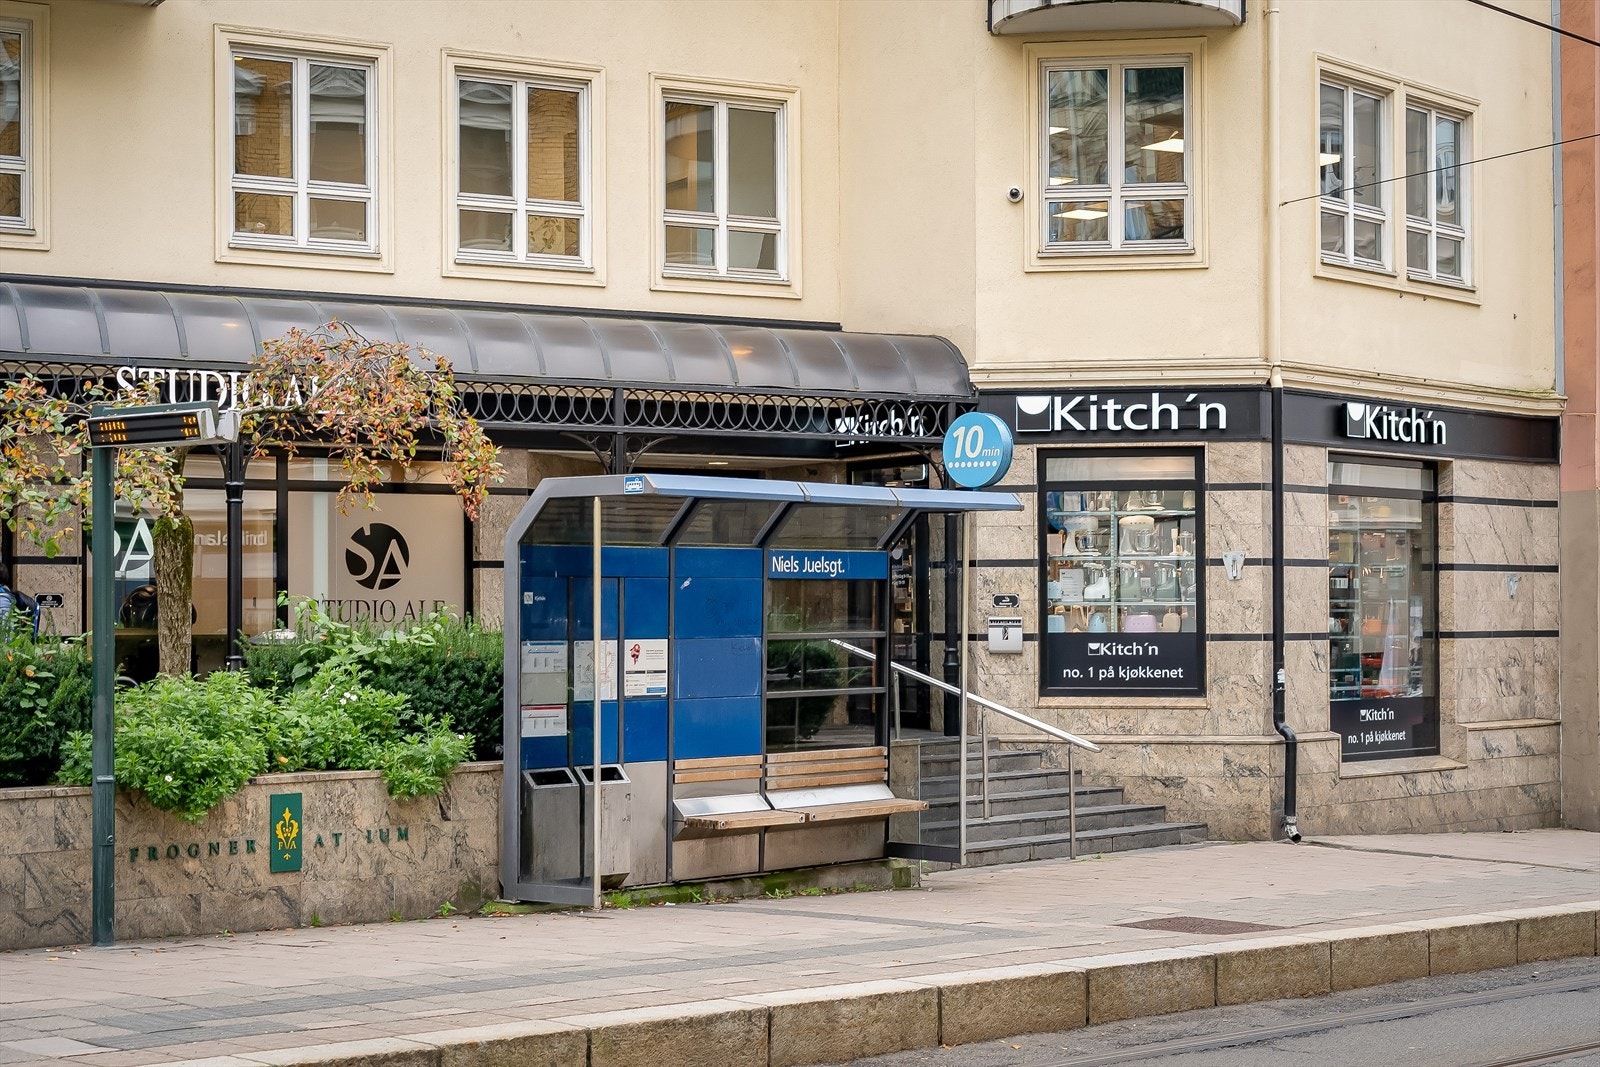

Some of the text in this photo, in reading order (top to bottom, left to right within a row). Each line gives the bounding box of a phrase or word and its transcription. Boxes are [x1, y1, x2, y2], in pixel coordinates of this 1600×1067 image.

[953, 425, 1000, 459] 10 min
[772, 555, 845, 578] Niels Juelsgt.
[1063, 665, 1184, 681] no. 1 på kjøkkenet
[1347, 730, 1406, 745] no. 1 på kjøkkenet
[129, 838, 258, 863] FROGNER
